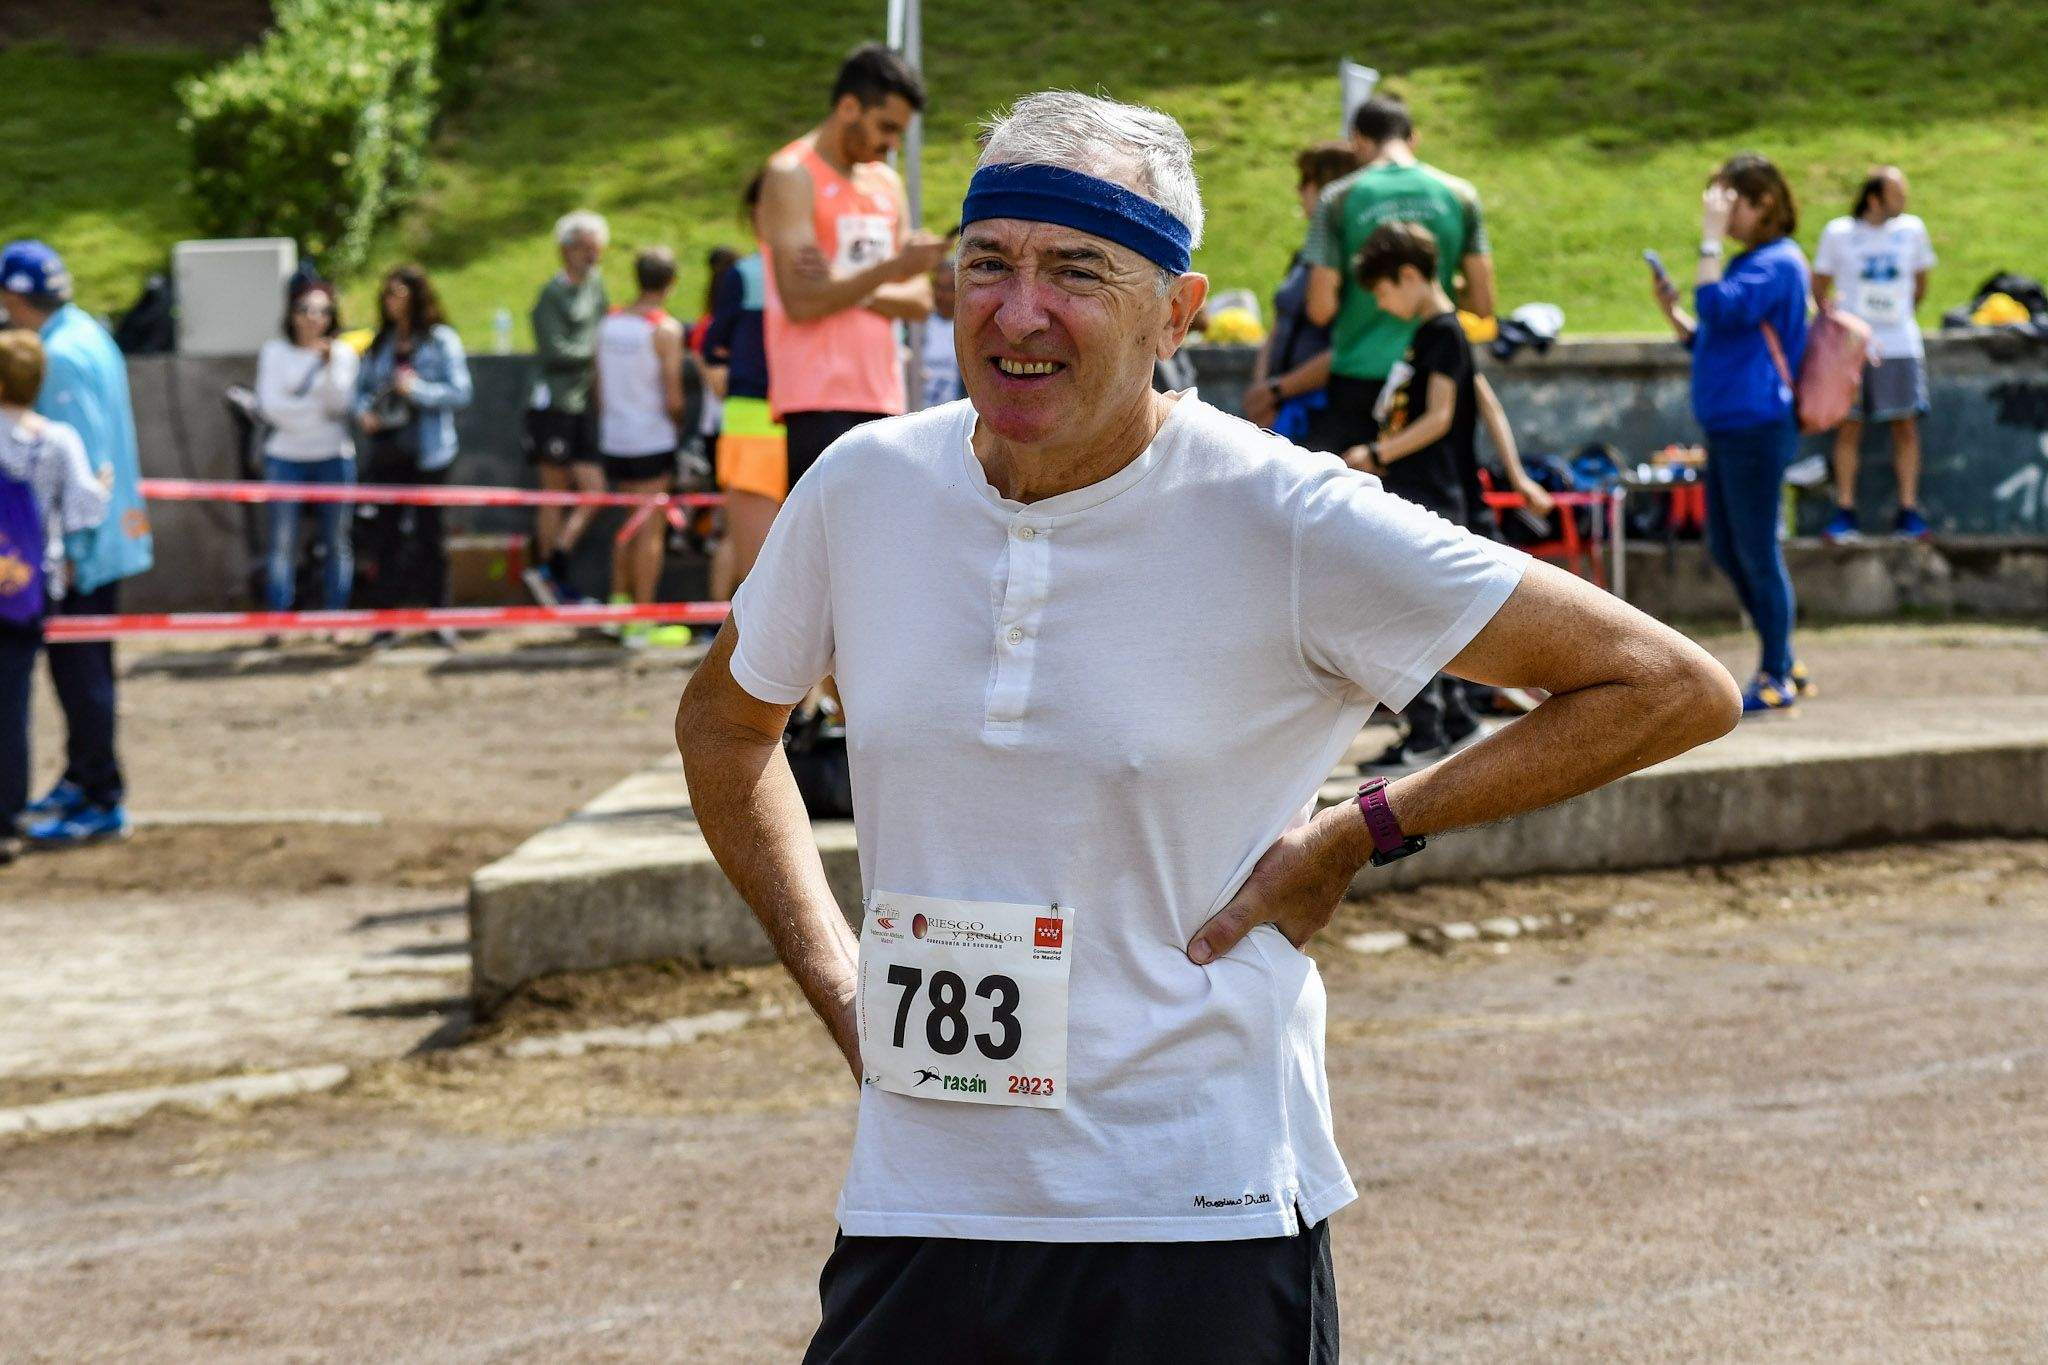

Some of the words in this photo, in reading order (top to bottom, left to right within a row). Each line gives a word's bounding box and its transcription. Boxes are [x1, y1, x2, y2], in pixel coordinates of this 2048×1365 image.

[928, 917, 984, 931] RIESGO
[951, 930, 961, 941] y
[966, 931, 1023, 943] gestión
[887, 964, 1022, 1061] 783
[943, 1073, 987, 1093] rasán
[1008, 1075, 1054, 1096] 2023
[1193, 1195, 1243, 1209] Massimo
[1244, 1194, 1272, 1206] Dutti
